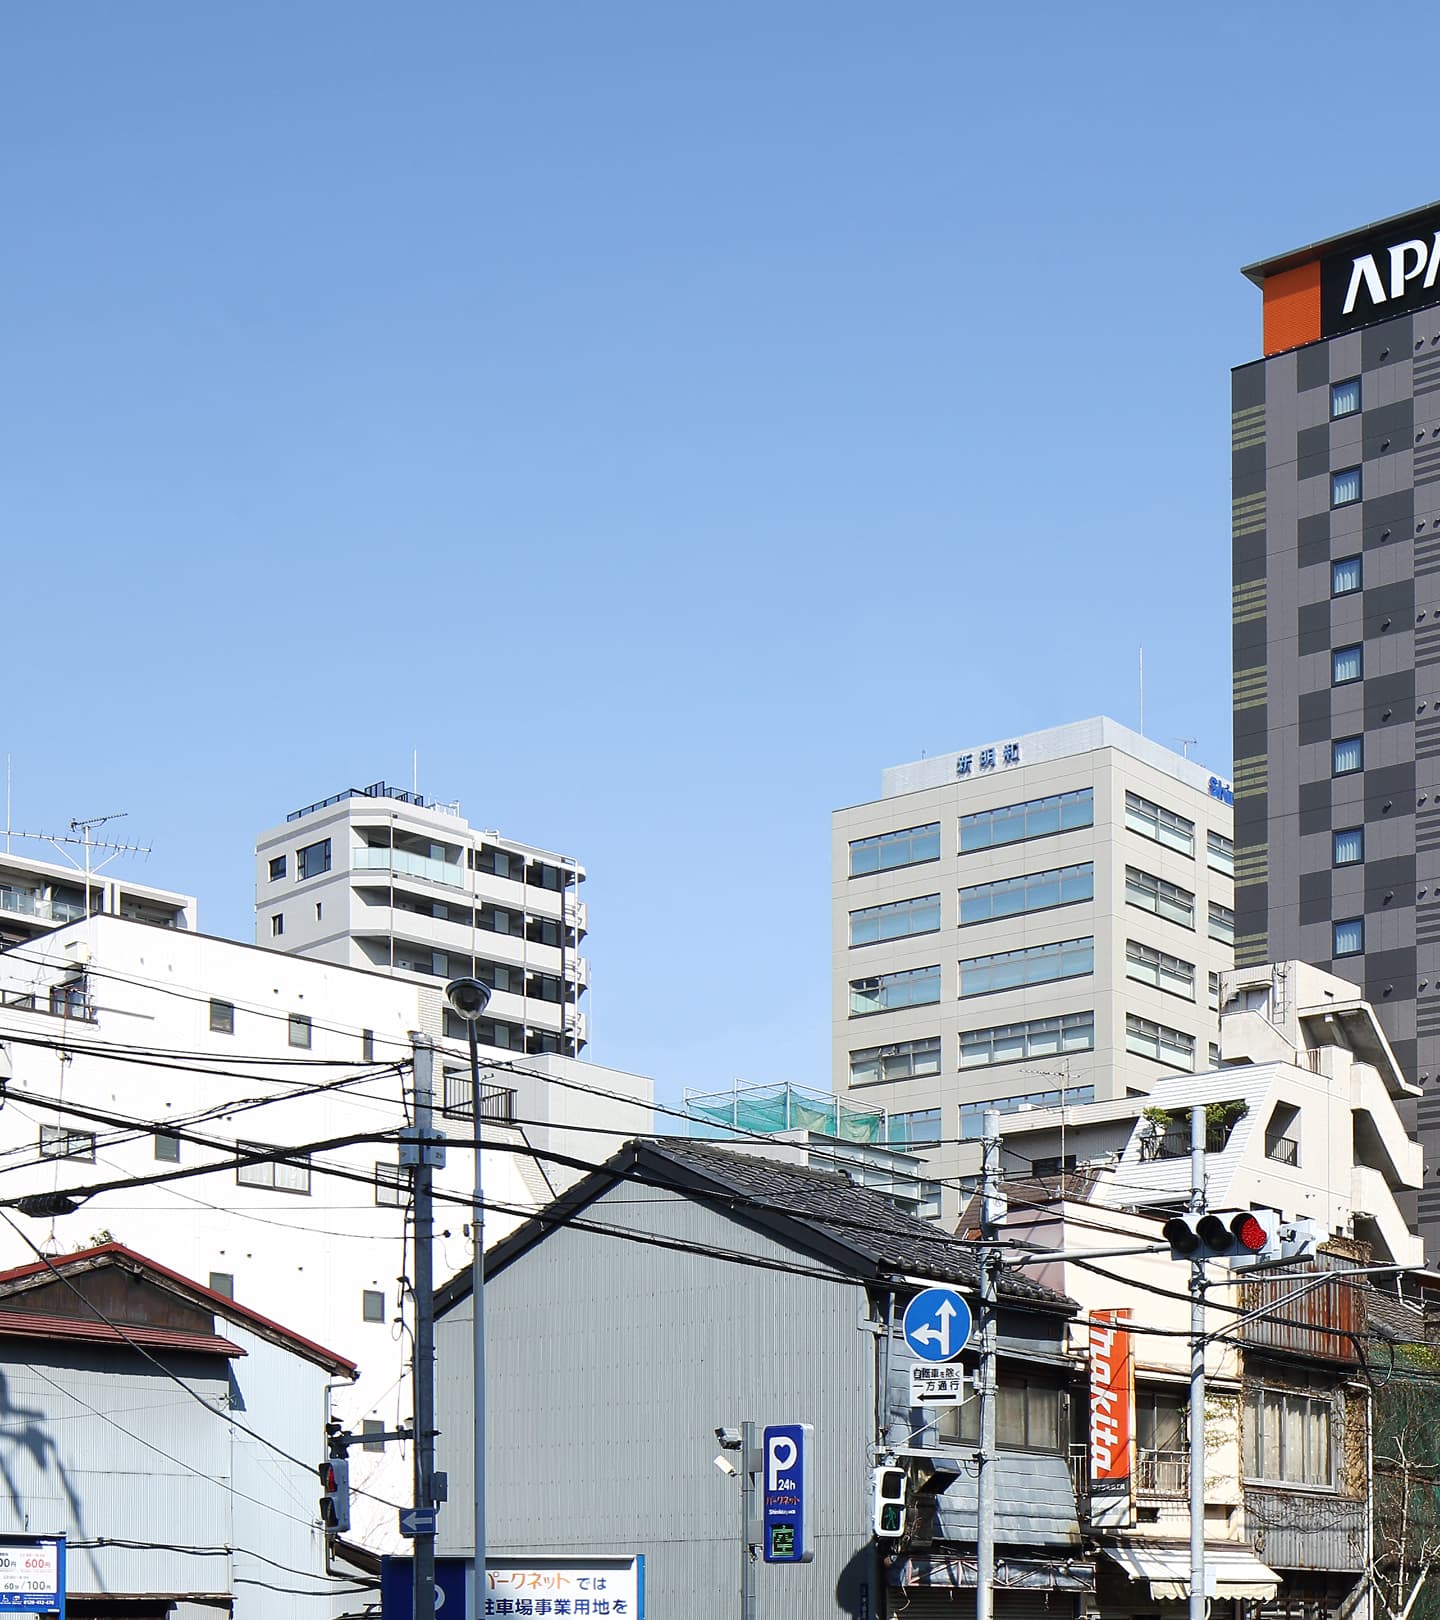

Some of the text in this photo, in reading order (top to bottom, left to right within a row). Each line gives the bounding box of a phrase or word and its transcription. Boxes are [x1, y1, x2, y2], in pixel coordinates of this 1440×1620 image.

[912, 1380, 960, 1391] 一方通行
[1089, 1316, 1118, 1480] makita
[778, 1479, 796, 1491] 24h
